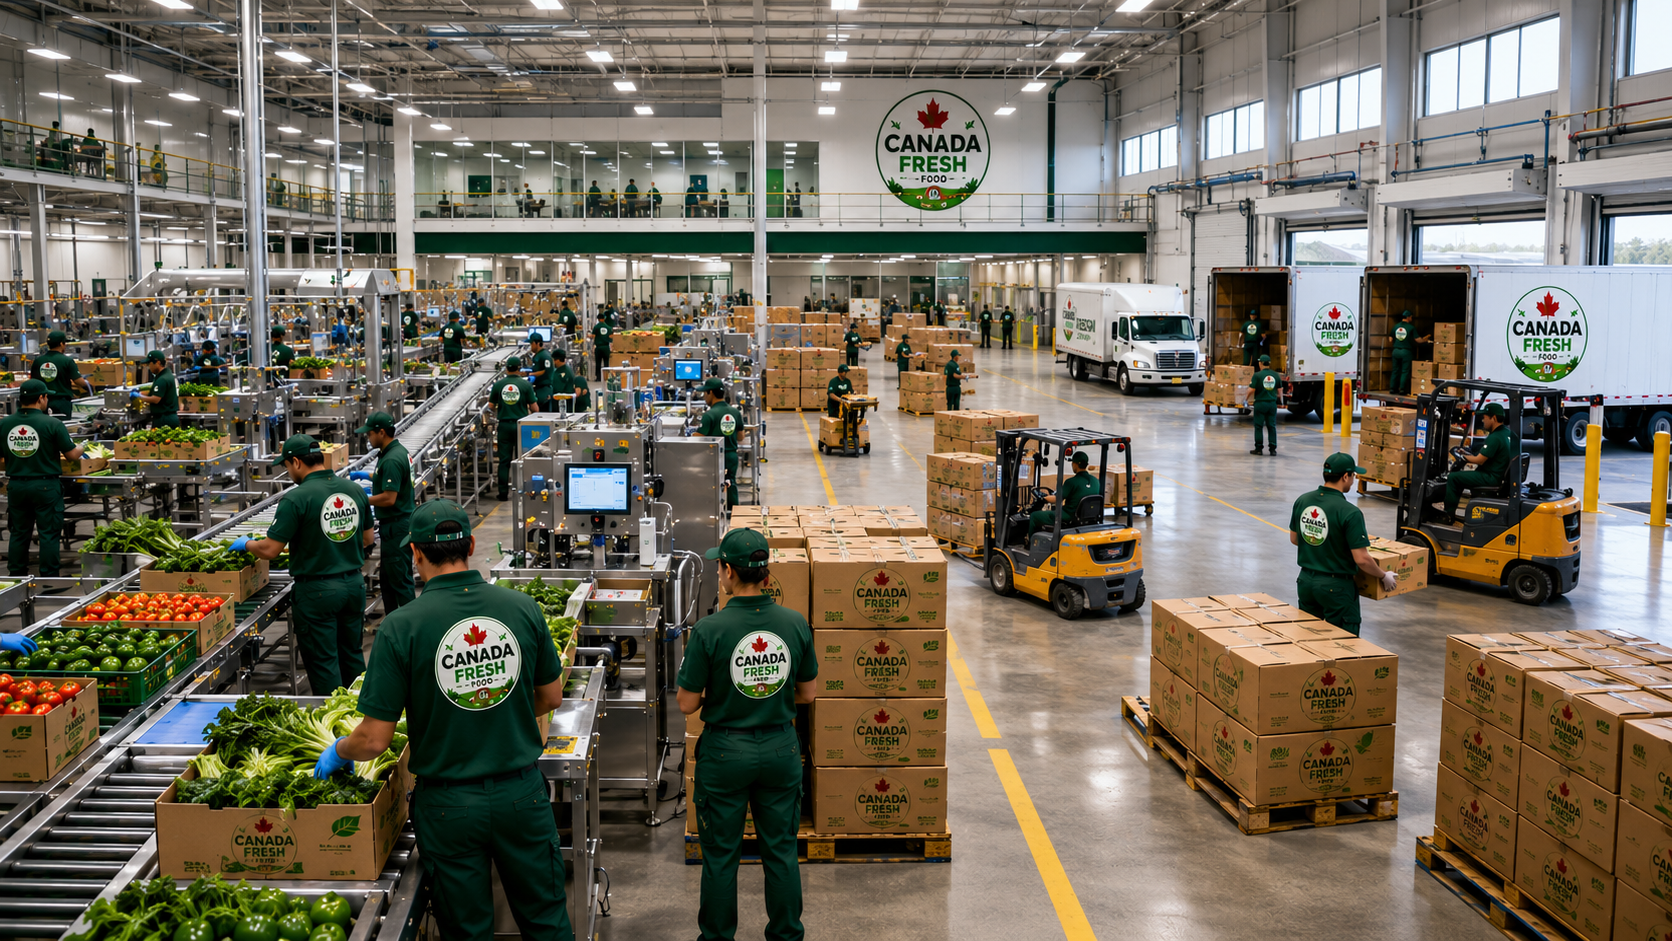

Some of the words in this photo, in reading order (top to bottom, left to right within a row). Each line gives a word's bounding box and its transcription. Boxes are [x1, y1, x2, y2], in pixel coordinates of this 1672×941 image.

[884, 134, 981, 152] CANADA
[899, 156, 966, 172] FRESH
[1315, 321, 1354, 330] CANADA
[1513, 321, 1582, 336] CANADA
[1523, 338, 1572, 352] FRESH
[856, 588, 908, 598] CANADA
[864, 599, 900, 608] FRESH
[441, 643, 515, 669] CANADA
[735, 652, 786, 667] CANADA
[856, 657, 908, 667] CANADA
[454, 660, 506, 683] FRESH
[743, 665, 779, 678] FRESH
[864, 668, 900, 677] FRESH
[1304, 686, 1353, 700] CANADA
[1311, 698, 1346, 710] FRESH
[856, 726, 908, 736] CANADA
[1550, 714, 1584, 740] CANADA
[864, 737, 900, 746] FRESH
[1303, 756, 1351, 770] CANADA
[1309, 767, 1343, 780] FRESH
[857, 794, 908, 804] CANADA
[1547, 790, 1581, 818] CANADA
[865, 805, 900, 814] FRESH
[234, 835, 294, 847] CANADA
[244, 847, 285, 858] FRESH
[1544, 864, 1578, 896] CANADA
